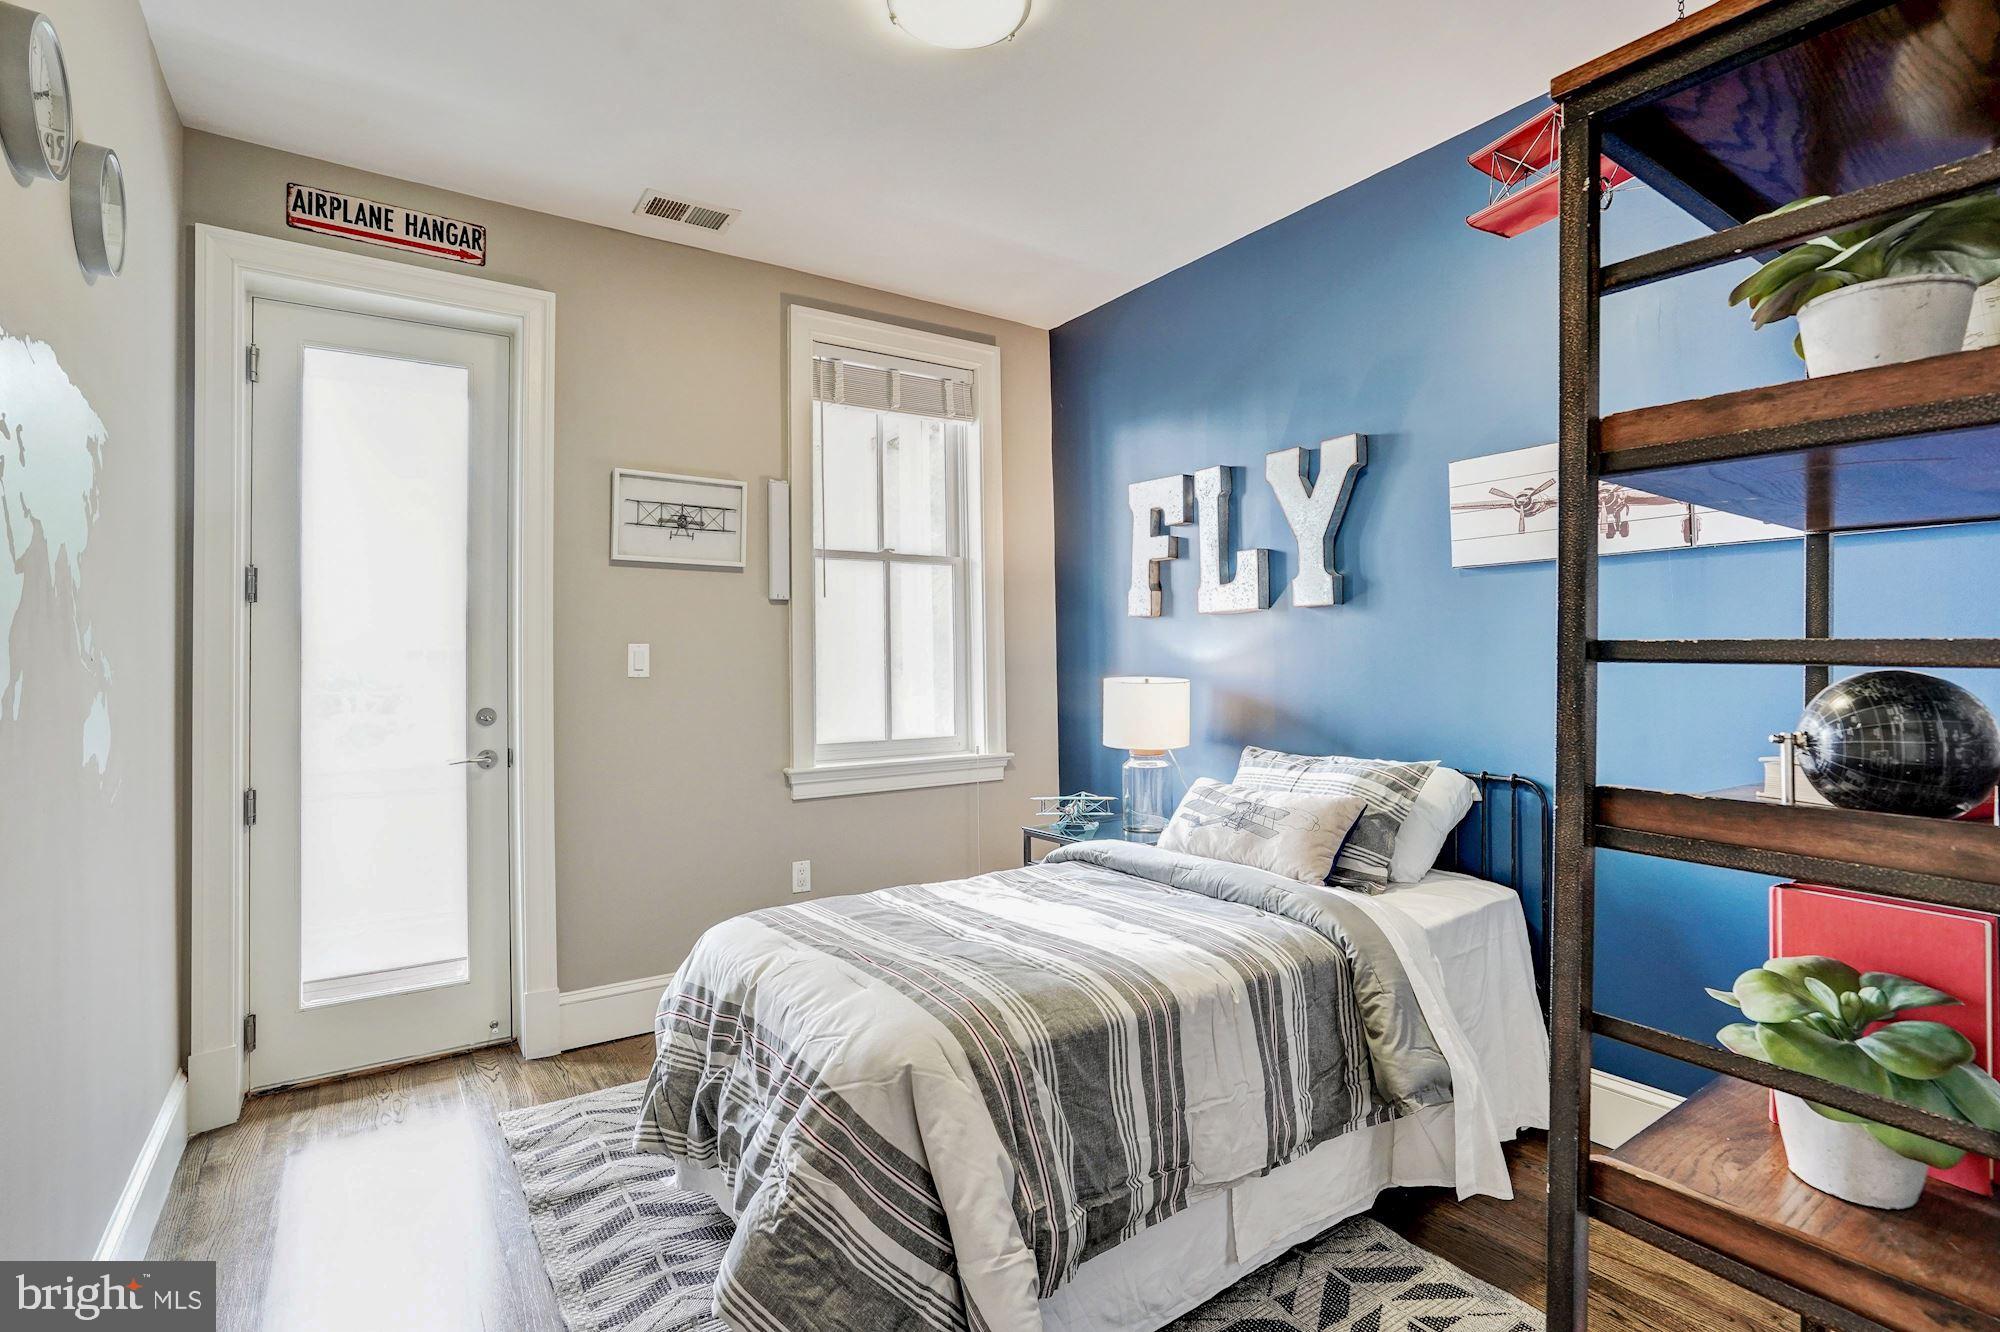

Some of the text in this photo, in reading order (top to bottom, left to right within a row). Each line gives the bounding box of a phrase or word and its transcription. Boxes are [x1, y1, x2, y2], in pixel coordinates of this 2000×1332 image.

[291, 188, 482, 251] AIRPLANE HANGAR
[1128, 433, 1368, 617] FLY
